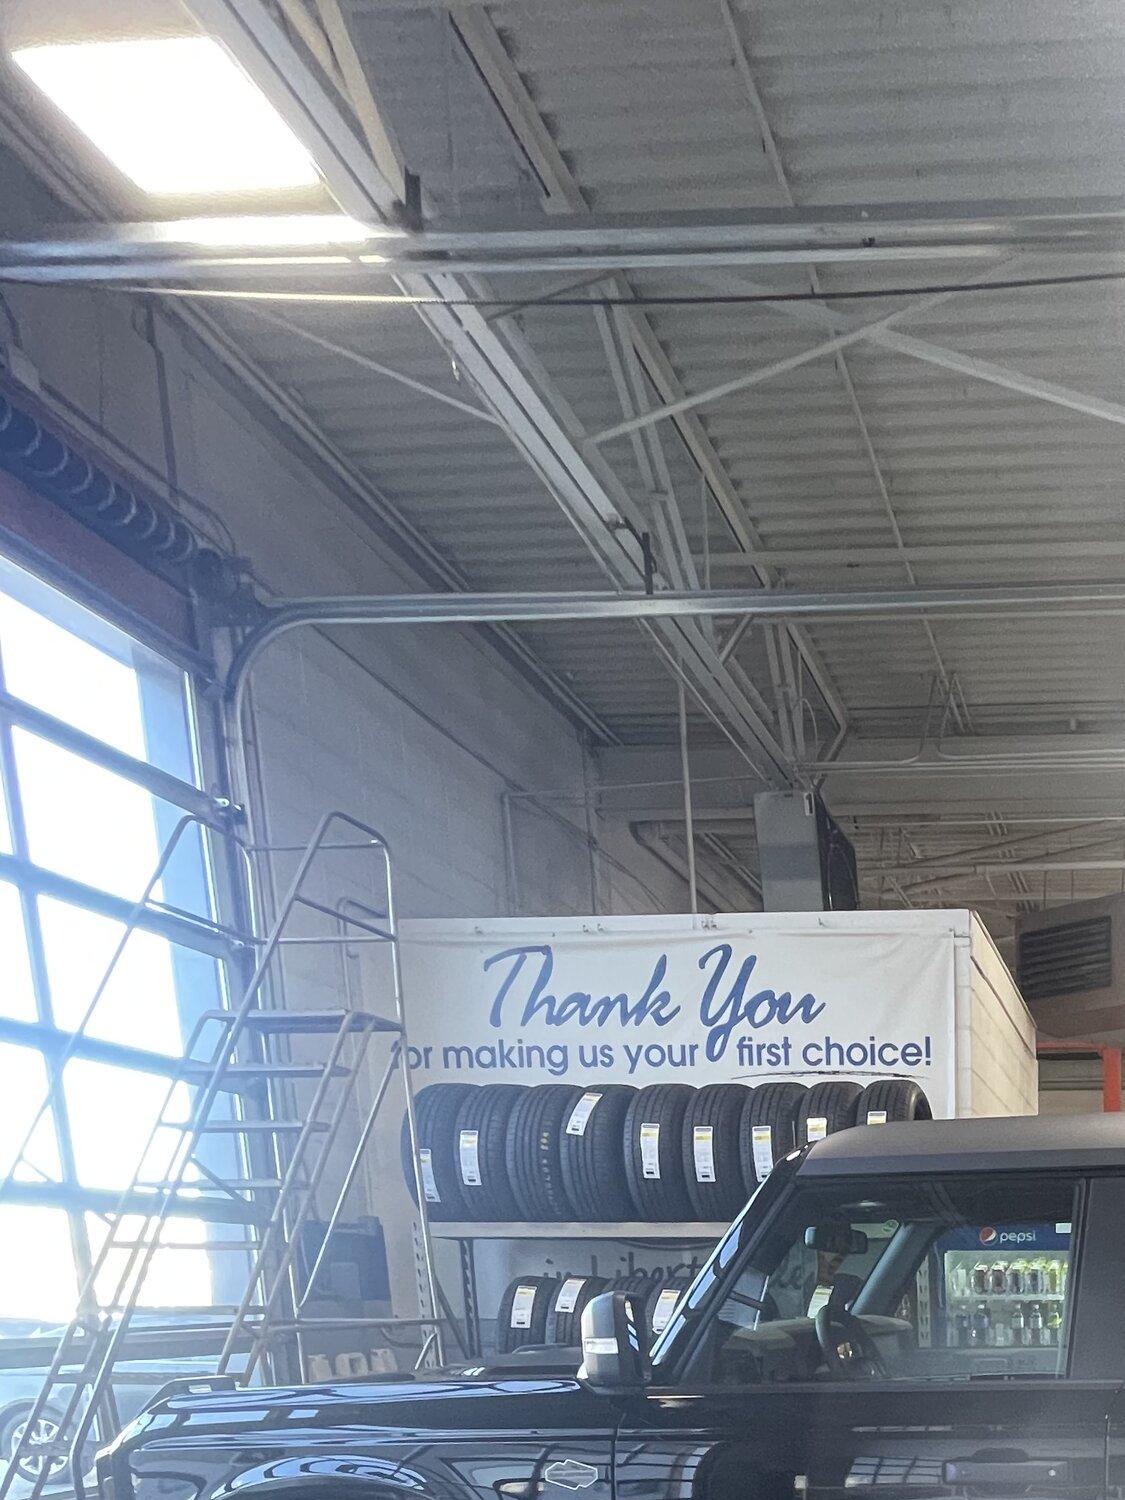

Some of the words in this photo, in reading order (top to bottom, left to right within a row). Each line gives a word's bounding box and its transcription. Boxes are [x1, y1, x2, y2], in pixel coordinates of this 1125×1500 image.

[483, 943, 681, 1028] Thank
[698, 943, 826, 1063] You
[442, 1038, 570, 1077] making
[578, 1043, 615, 1069] us
[623, 1043, 700, 1075] your
[736, 1036, 793, 1067] first
[802, 1036, 932, 1067] choice!
[999, 1229, 1036, 1244] pepsi
